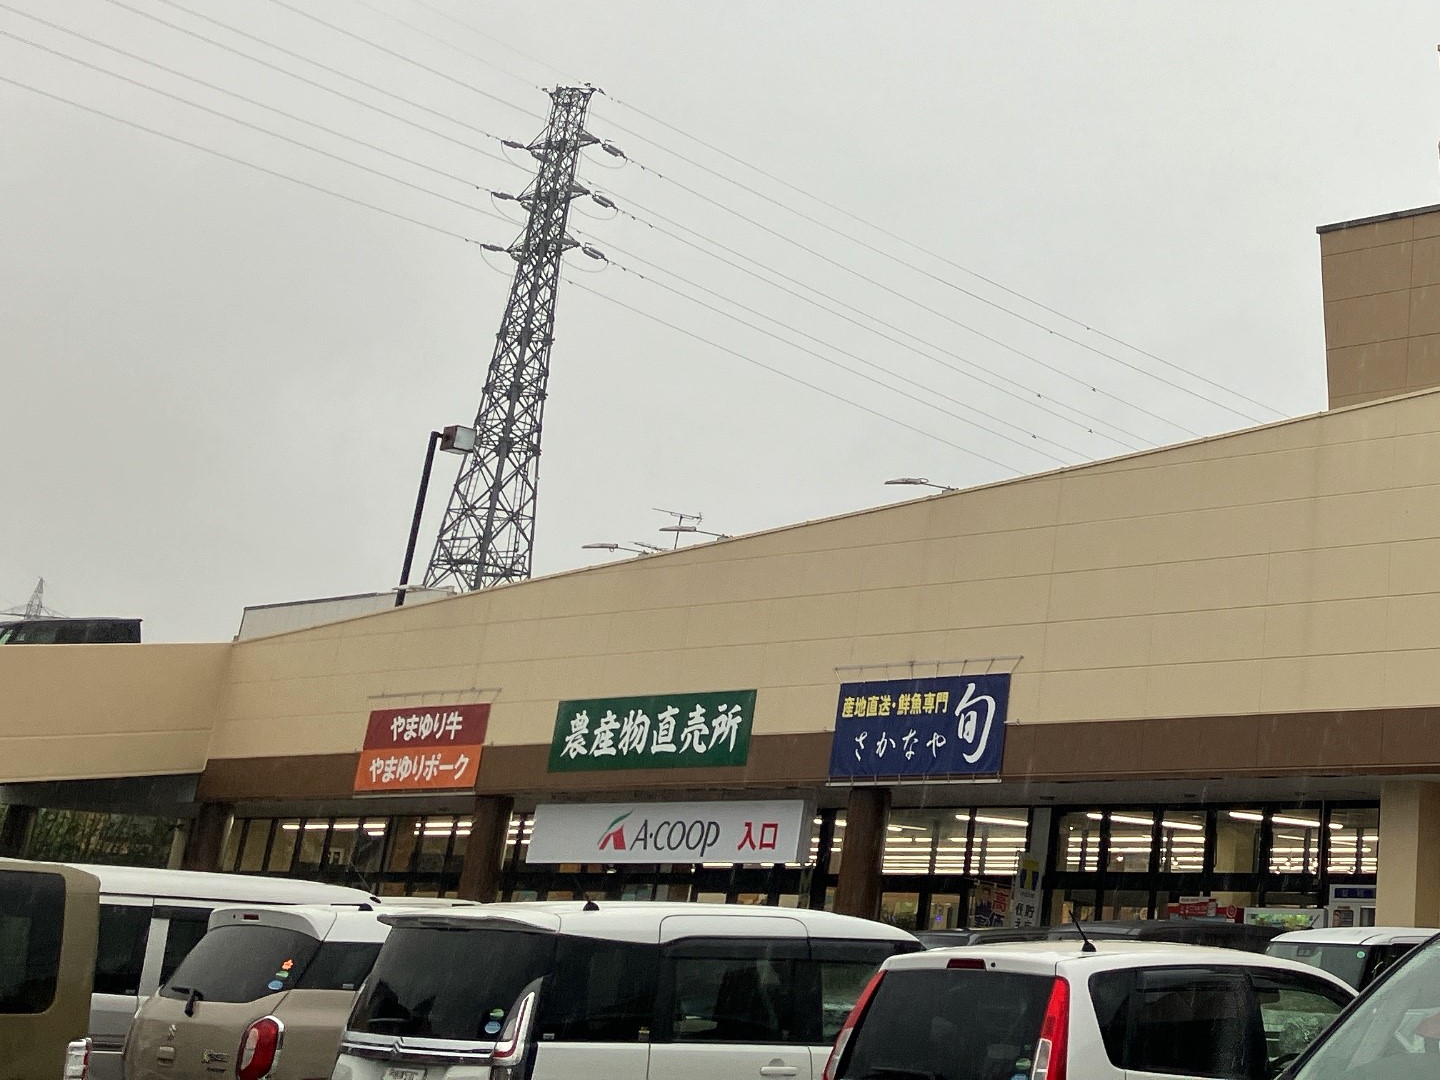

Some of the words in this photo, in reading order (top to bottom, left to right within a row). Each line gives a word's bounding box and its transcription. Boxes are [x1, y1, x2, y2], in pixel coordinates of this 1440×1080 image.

[842, 691, 950, 718] 産地直送・鮮魚専門
[390, 711, 463, 741] やまゆり牛
[560, 704, 743, 759] 農産物直売所
[954, 682, 996, 764] 旬
[854, 728, 947, 762] さかなや
[369, 753, 470, 783] やまゆりポーク
[737, 821, 779, 851] 入口
